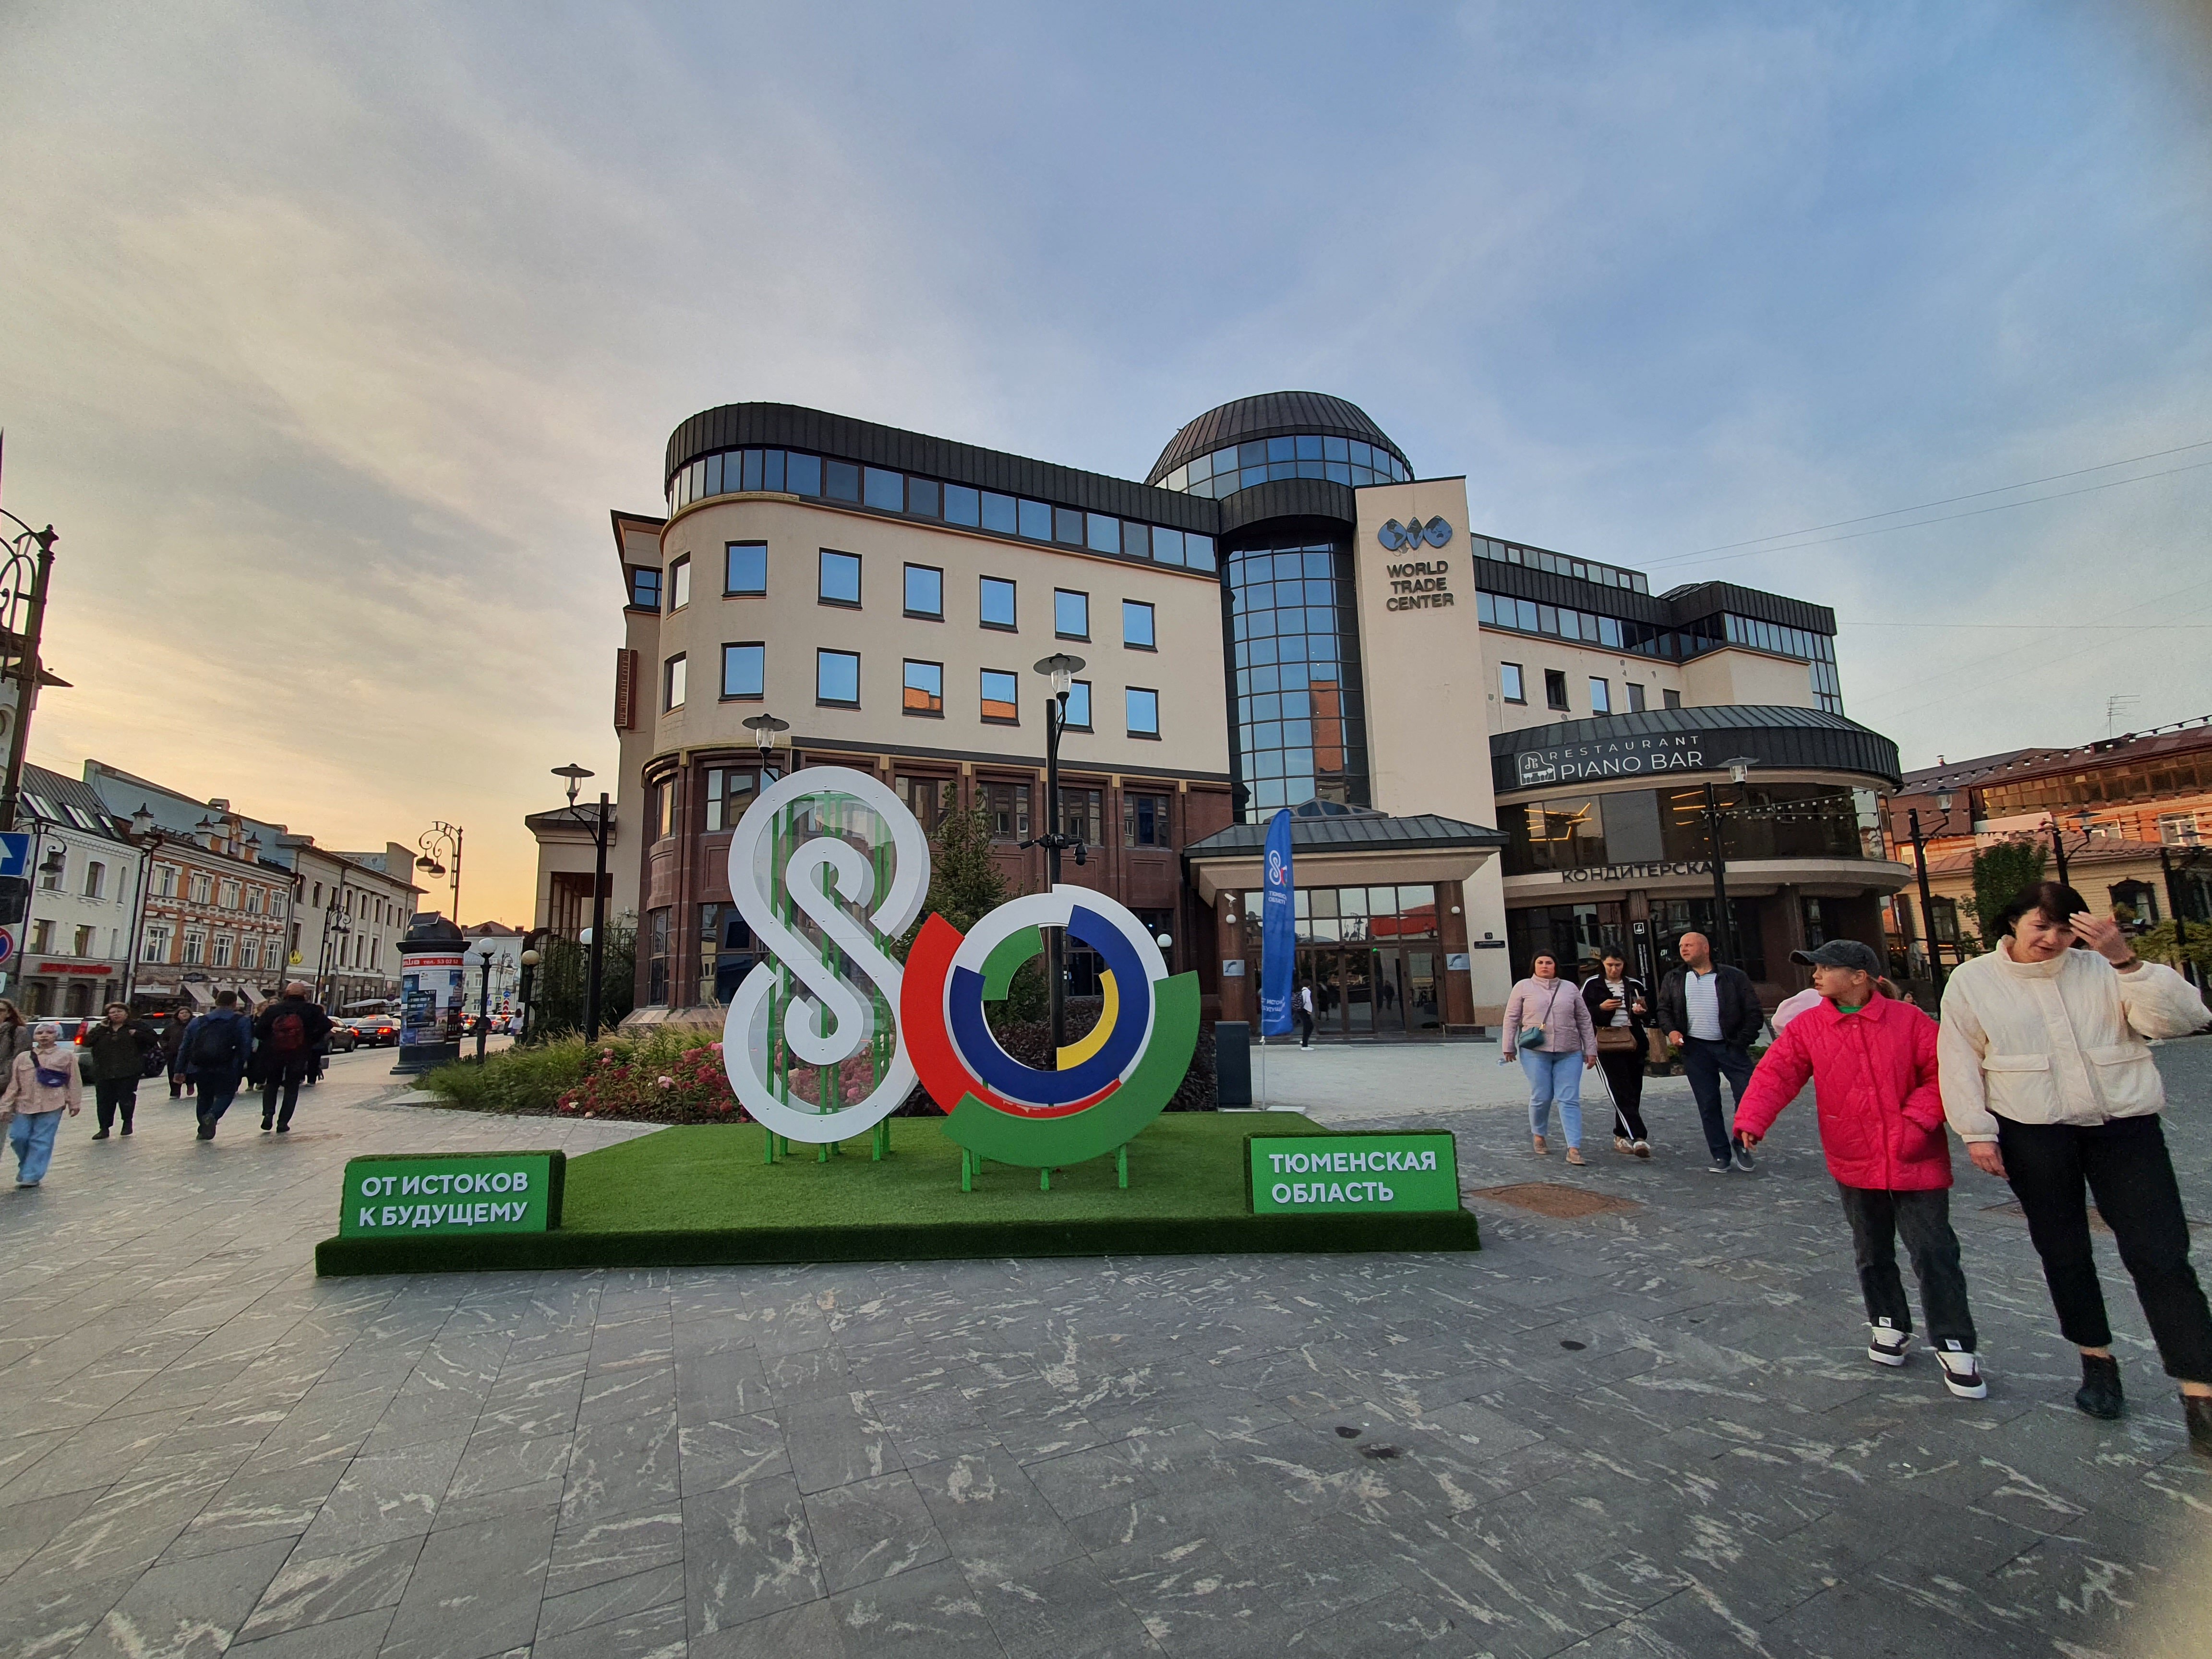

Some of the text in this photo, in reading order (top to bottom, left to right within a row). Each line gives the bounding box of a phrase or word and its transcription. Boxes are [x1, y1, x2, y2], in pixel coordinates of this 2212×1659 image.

[1386, 560, 1448, 578] WORLD
[1390, 577, 1447, 594] TRADE
[1386, 593, 1454, 612] CENTER
[1550, 735, 1700, 760] RESTAURANT
[1561, 751, 1703, 780] PIANO BAR
[1269, 1151, 1436, 1173] ТЮМЕНСКАЯ
[361, 1172, 528, 1197] ОТ ИСТОКОВ
[1272, 1182, 1394, 1203] ОБЛАСТЬ
[359, 1202, 528, 1228] К БУДУЩЕМУ
